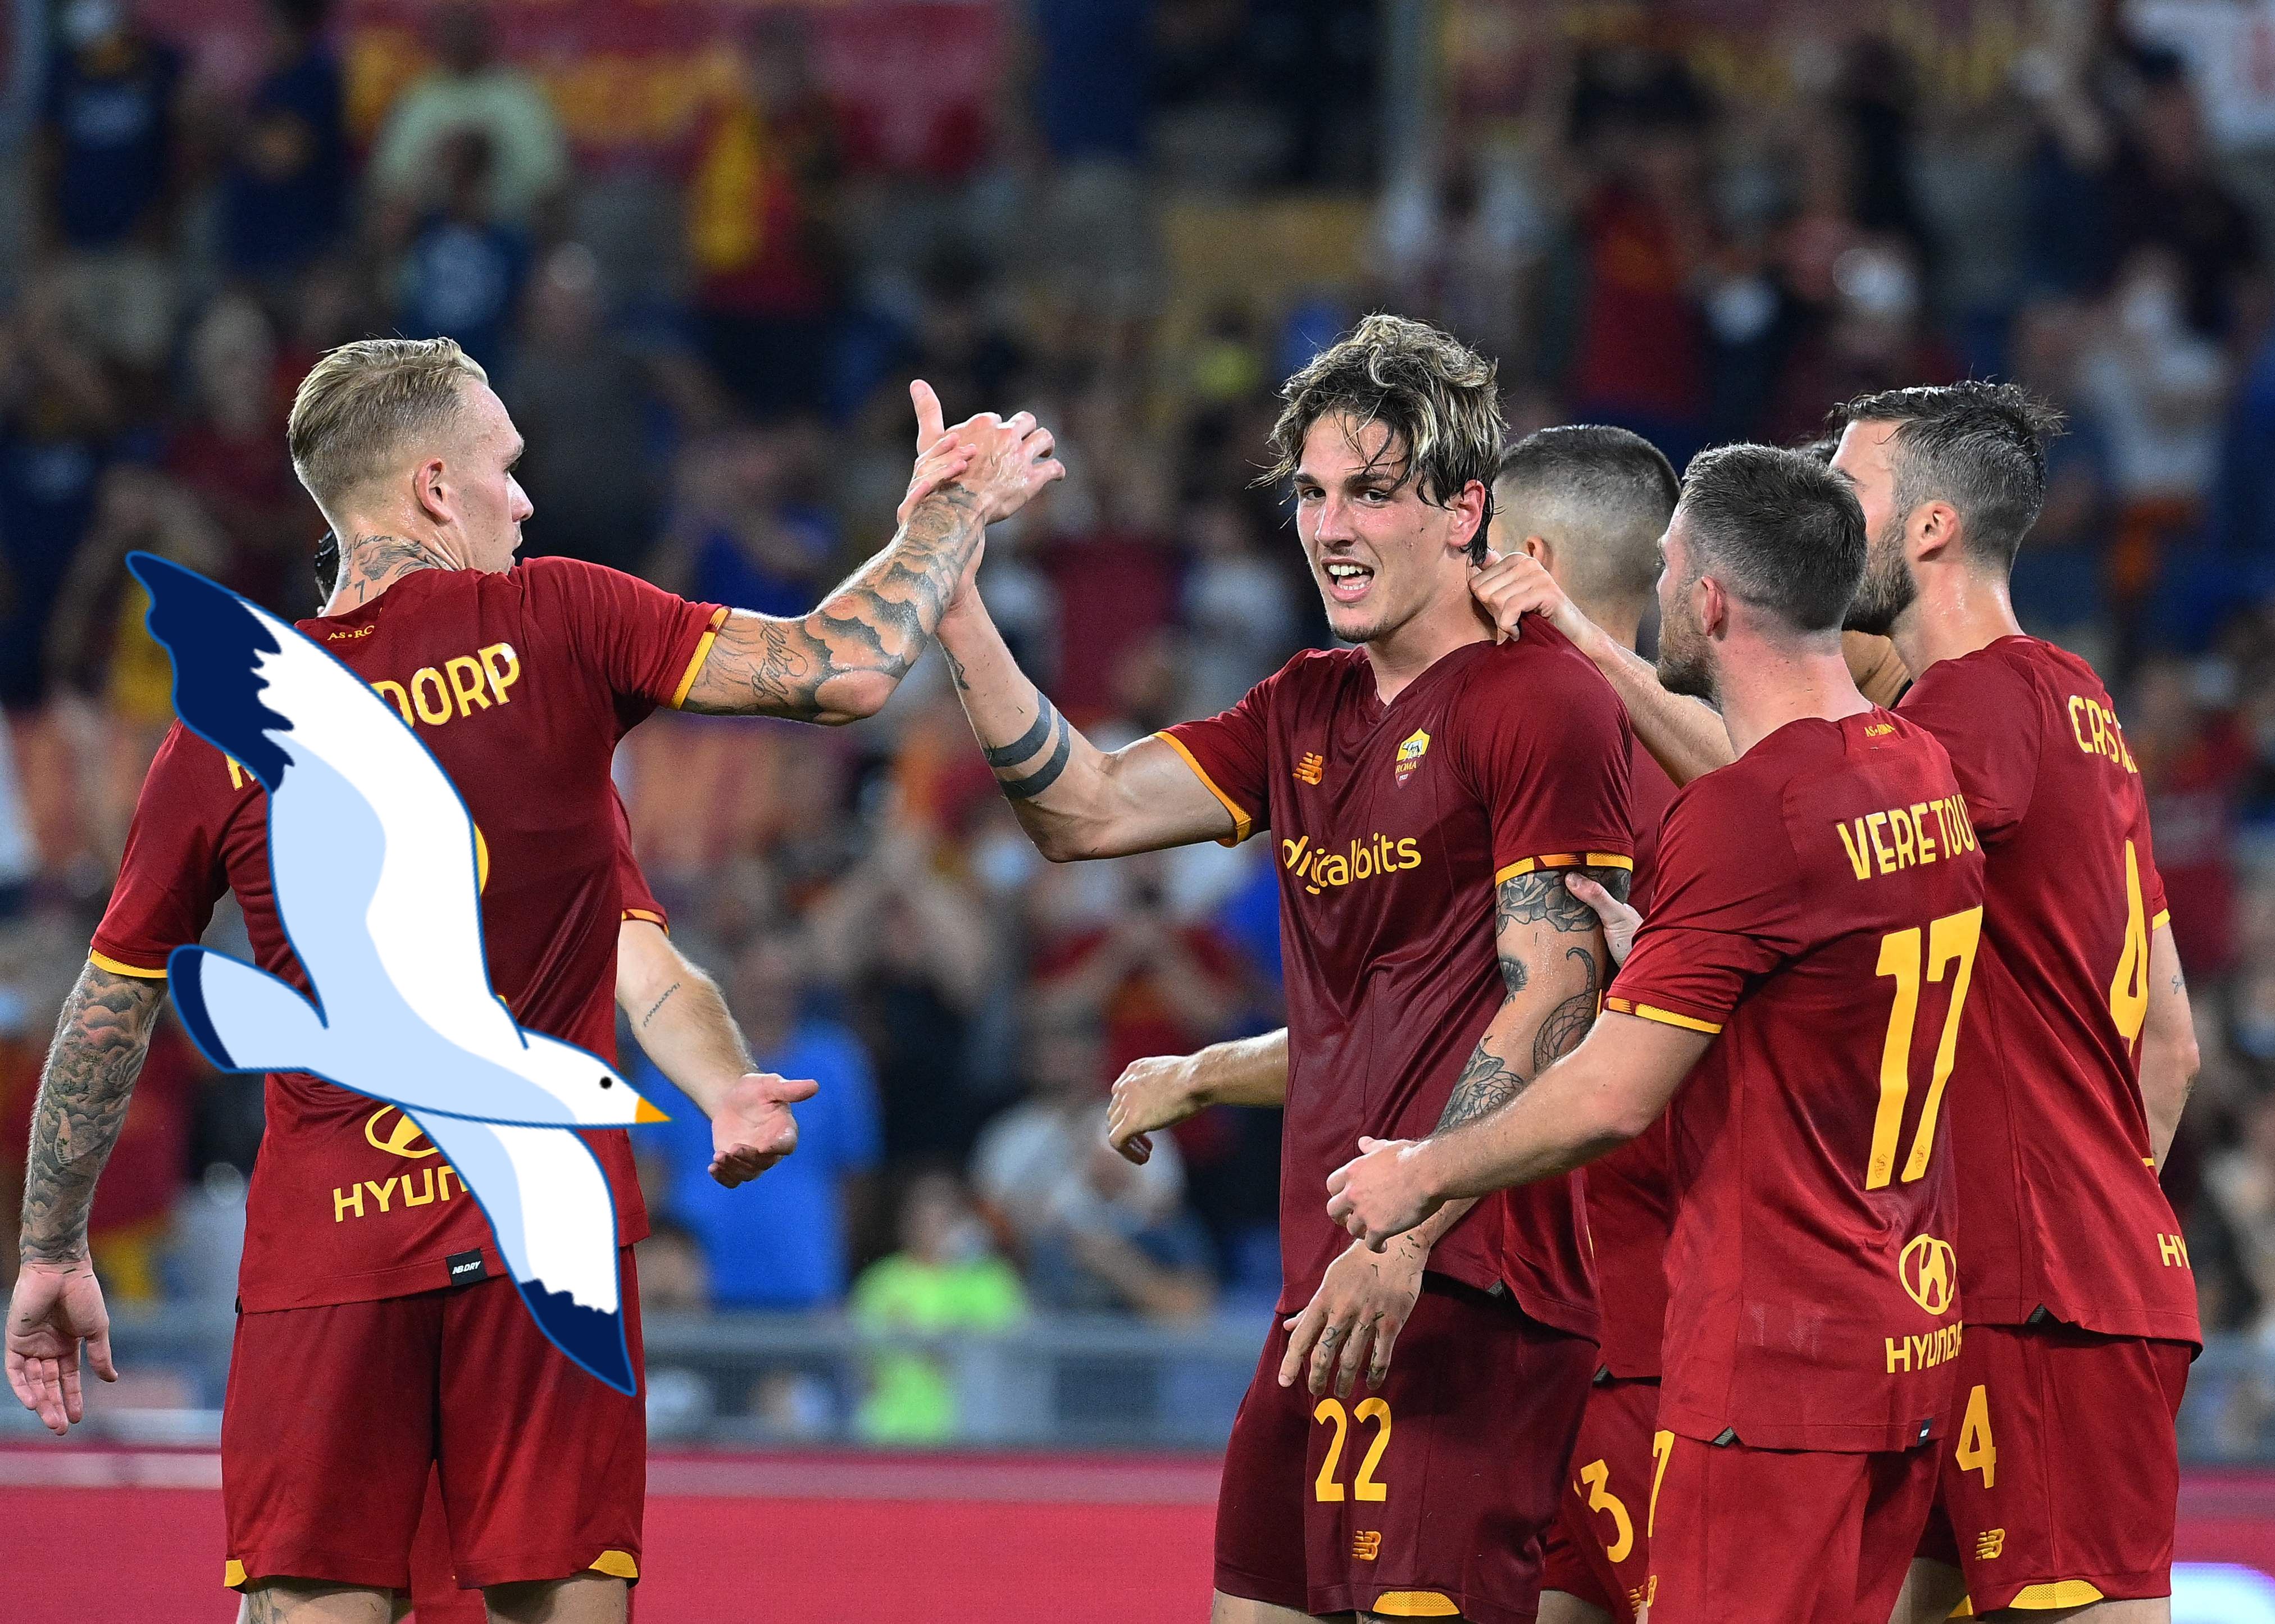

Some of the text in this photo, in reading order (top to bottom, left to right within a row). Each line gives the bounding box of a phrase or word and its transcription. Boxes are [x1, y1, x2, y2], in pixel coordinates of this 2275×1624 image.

[1836, 793, 1976, 881] VERETOU
[1866, 905, 1983, 1190] 17
[333, 1164, 468, 1223] HYUN
[1313, 1397, 1392, 1502] 22
[1955, 1384, 1996, 1489] 4
[1573, 1458, 1634, 1563] 3
